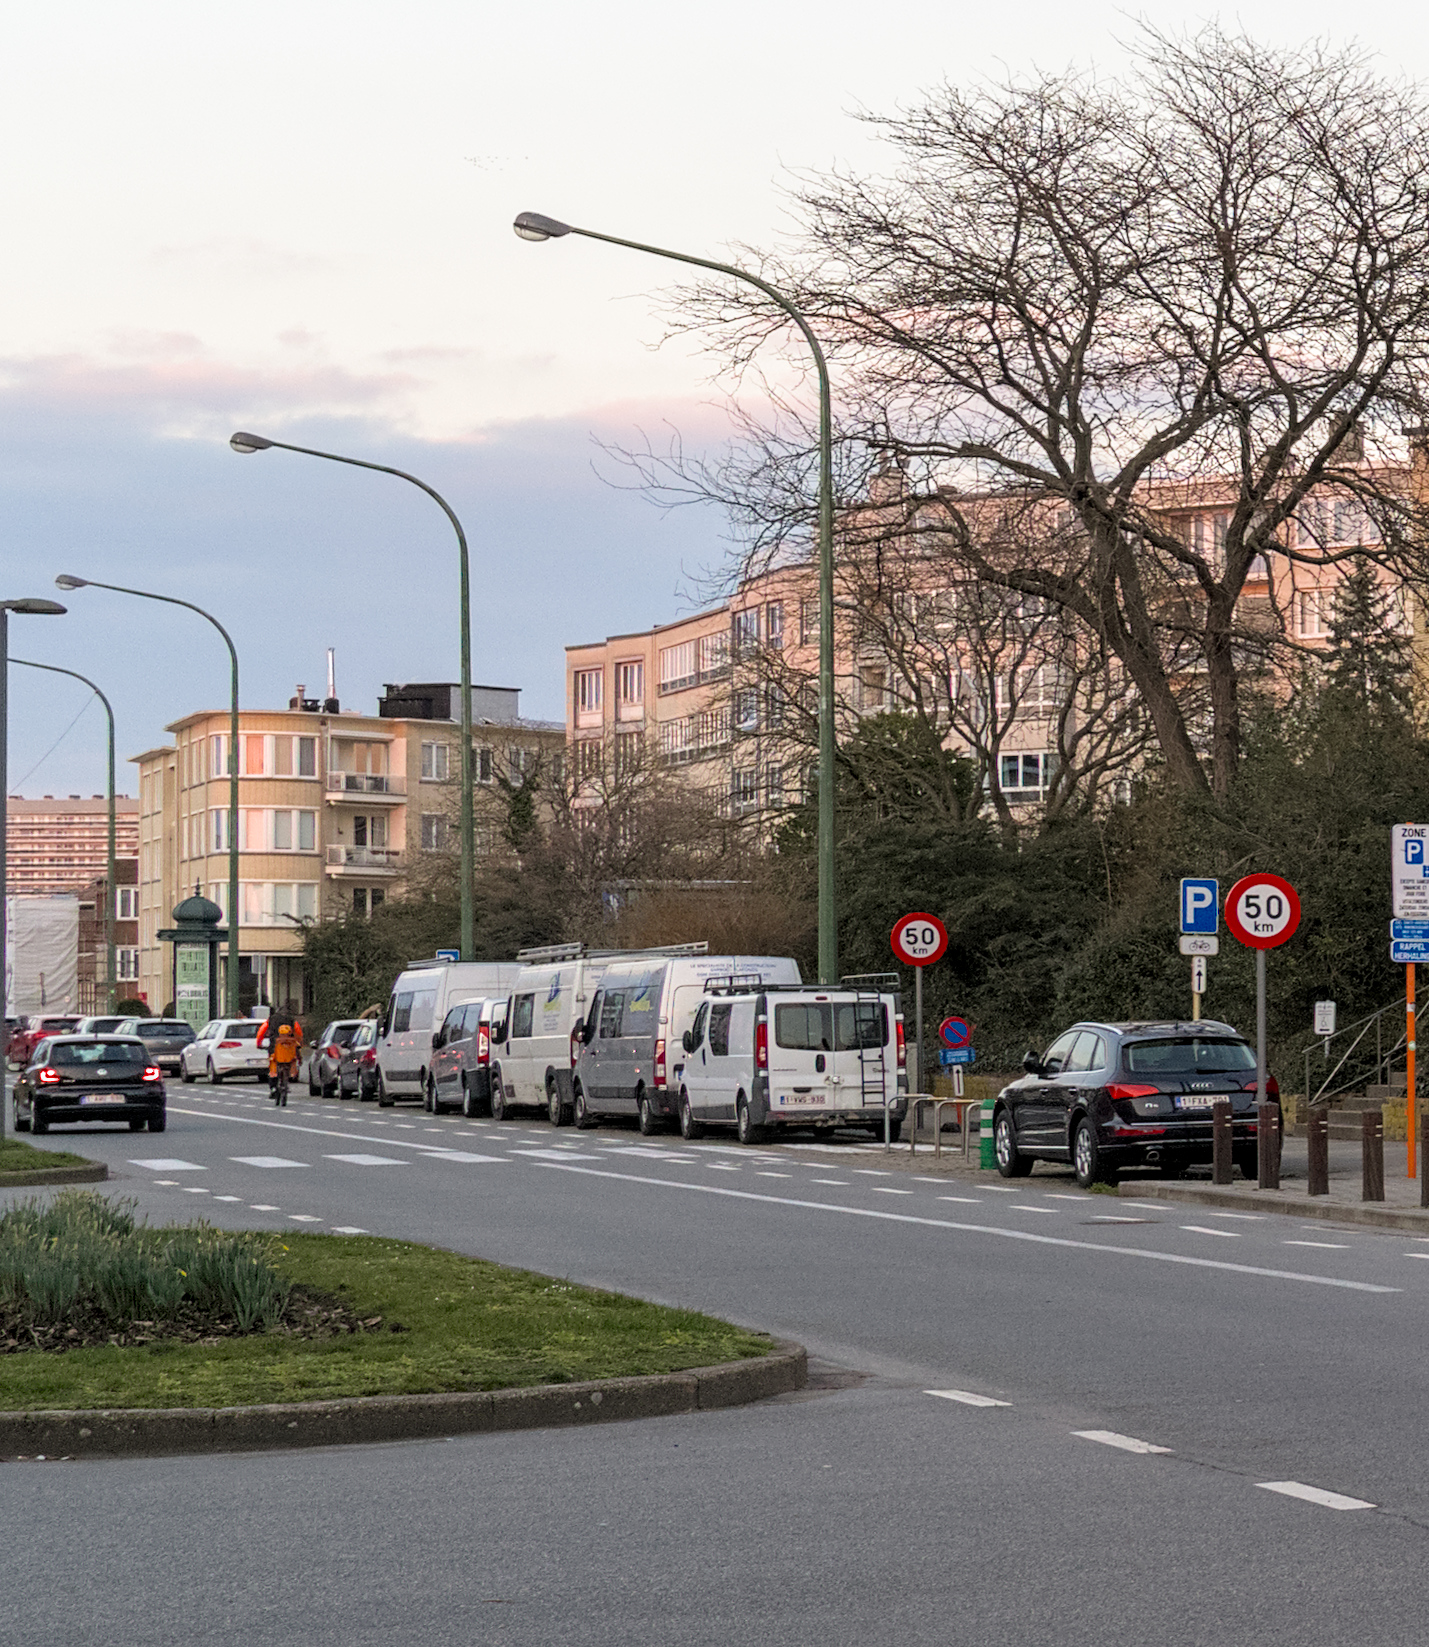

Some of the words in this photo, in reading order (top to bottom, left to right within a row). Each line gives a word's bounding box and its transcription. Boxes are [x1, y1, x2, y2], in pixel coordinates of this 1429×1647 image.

[1401, 828, 1427, 837] ZONE
[1407, 842, 1421, 862] P
[1186, 886, 1213, 924] P
[1244, 895, 1283, 919] 50
[1254, 921, 1274, 932] km
[905, 928, 935, 945] 50
[912, 946, 928, 955] km
